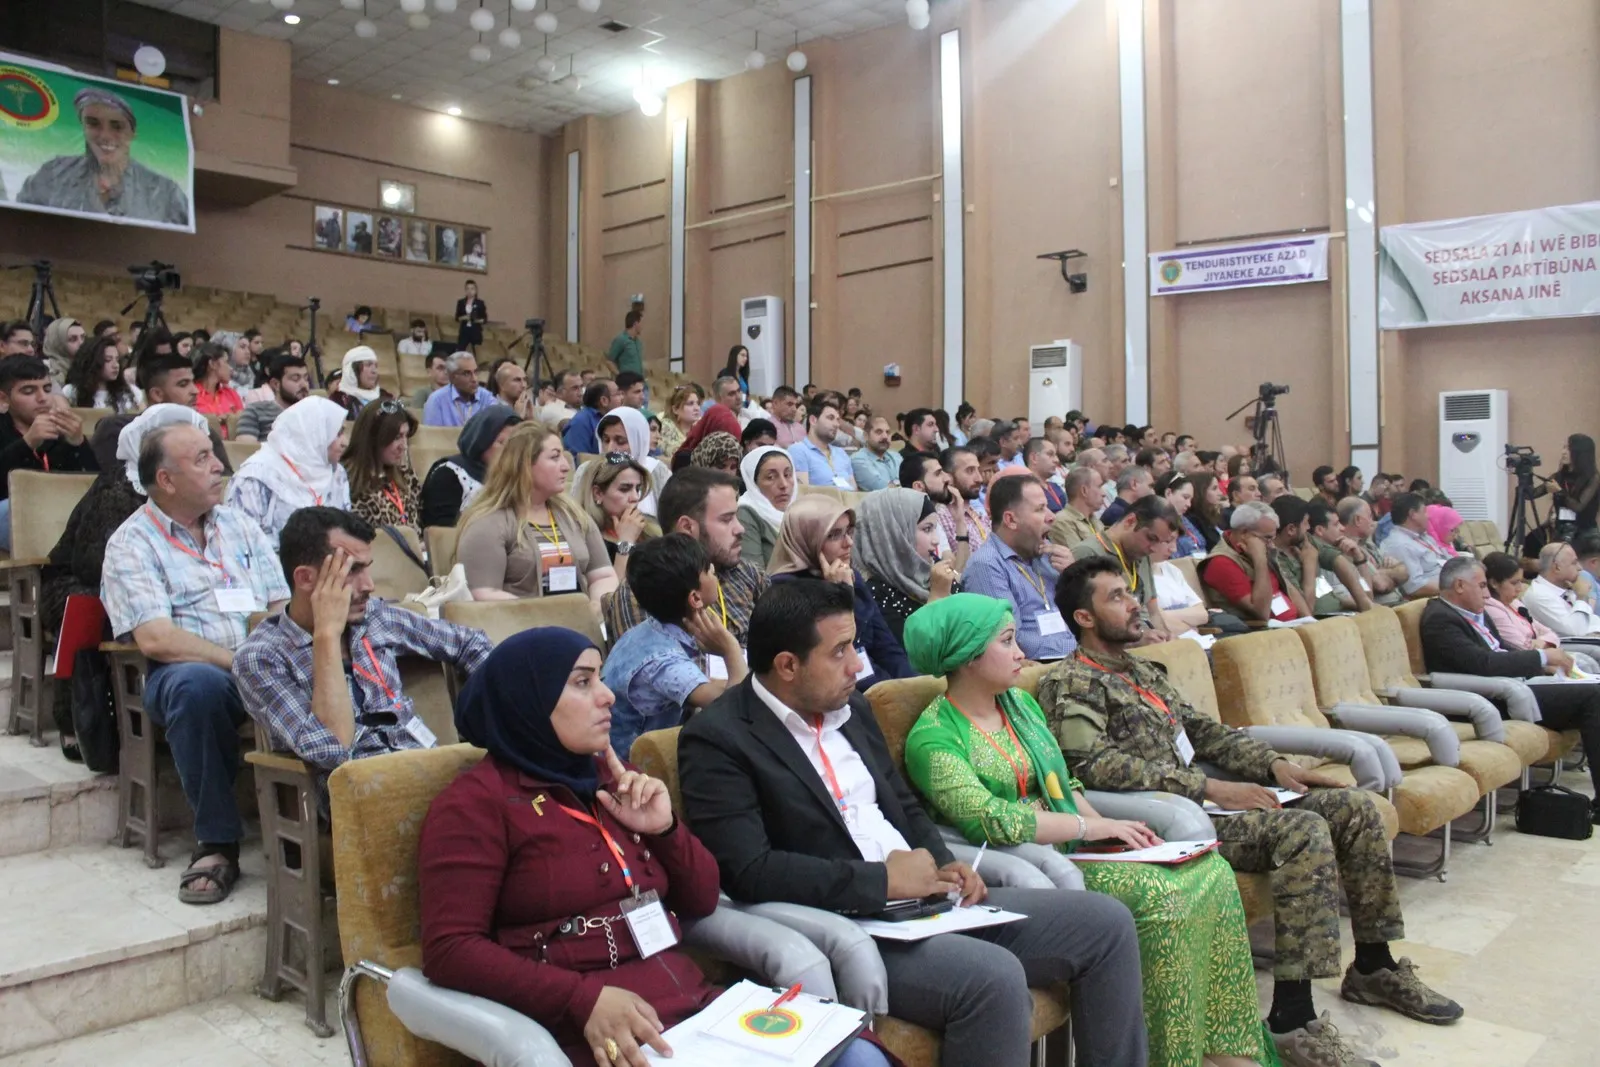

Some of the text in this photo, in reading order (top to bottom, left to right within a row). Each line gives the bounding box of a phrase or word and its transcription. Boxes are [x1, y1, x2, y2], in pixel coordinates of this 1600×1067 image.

[1277, 249, 1306, 261] AZAD
[1425, 247, 1488, 264] SEDSALA
[1493, 244, 1508, 258] 21
[1512, 240, 1535, 256] AN
[1540, 234, 1566, 253] WÊ
[1204, 265, 1286, 282] JIYANEKE AZAD
[1433, 267, 1498, 286] SEDSALA
[1460, 281, 1561, 305] AKSANA JINÊ
